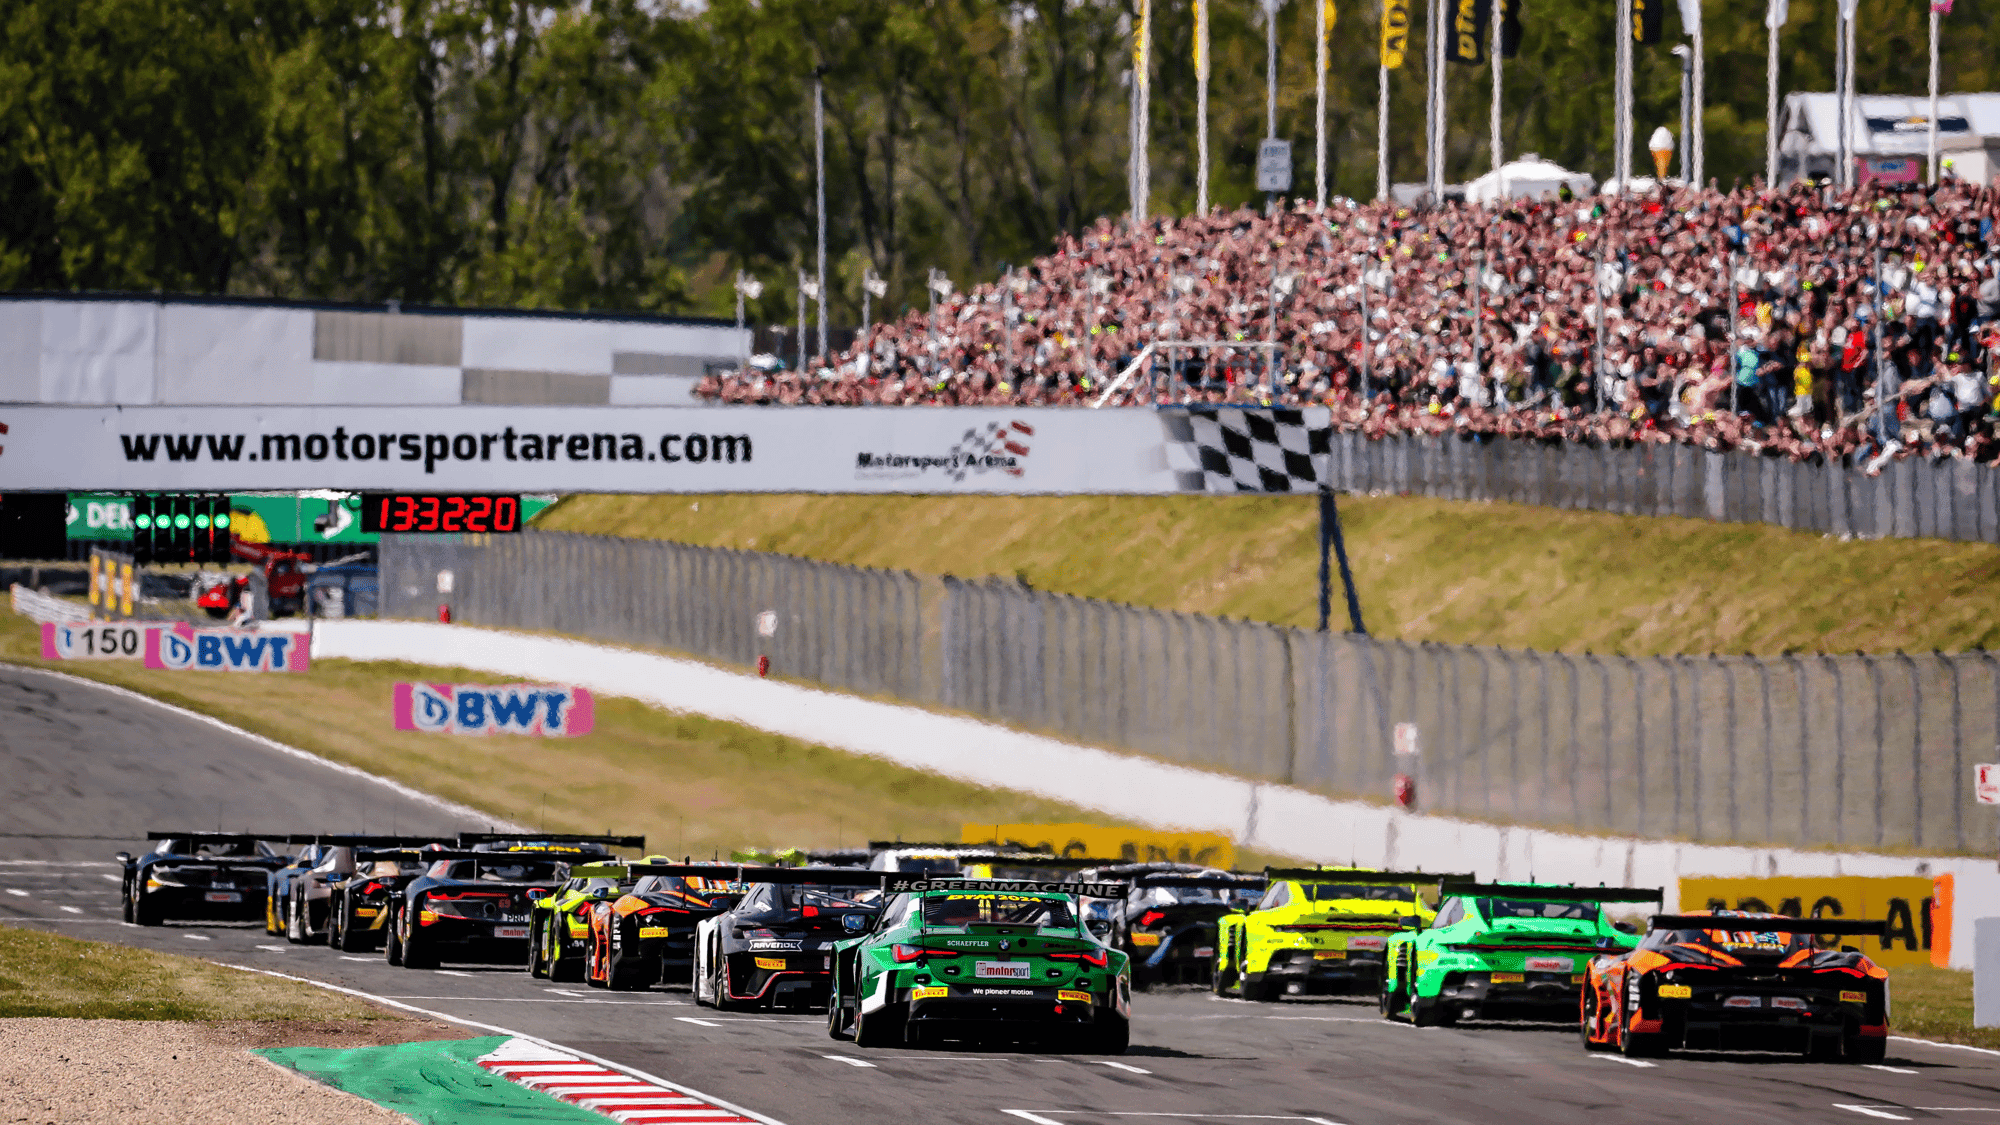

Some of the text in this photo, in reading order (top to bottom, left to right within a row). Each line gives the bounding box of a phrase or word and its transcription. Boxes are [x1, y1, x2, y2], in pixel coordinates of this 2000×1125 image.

[120, 427, 753, 474] www.motorsportarena.com
[857, 451, 1017, 471] Motorsport Arena
[380, 497, 516, 532] 13:32:20
[81, 628, 138, 655] 150
[197, 634, 288, 668] BWT
[456, 689, 568, 730] BWT
[892, 879, 1120, 897] #GREENMACHINE
[984, 988, 1010, 997] pioneer
[1010, 988, 1034, 996] motion
